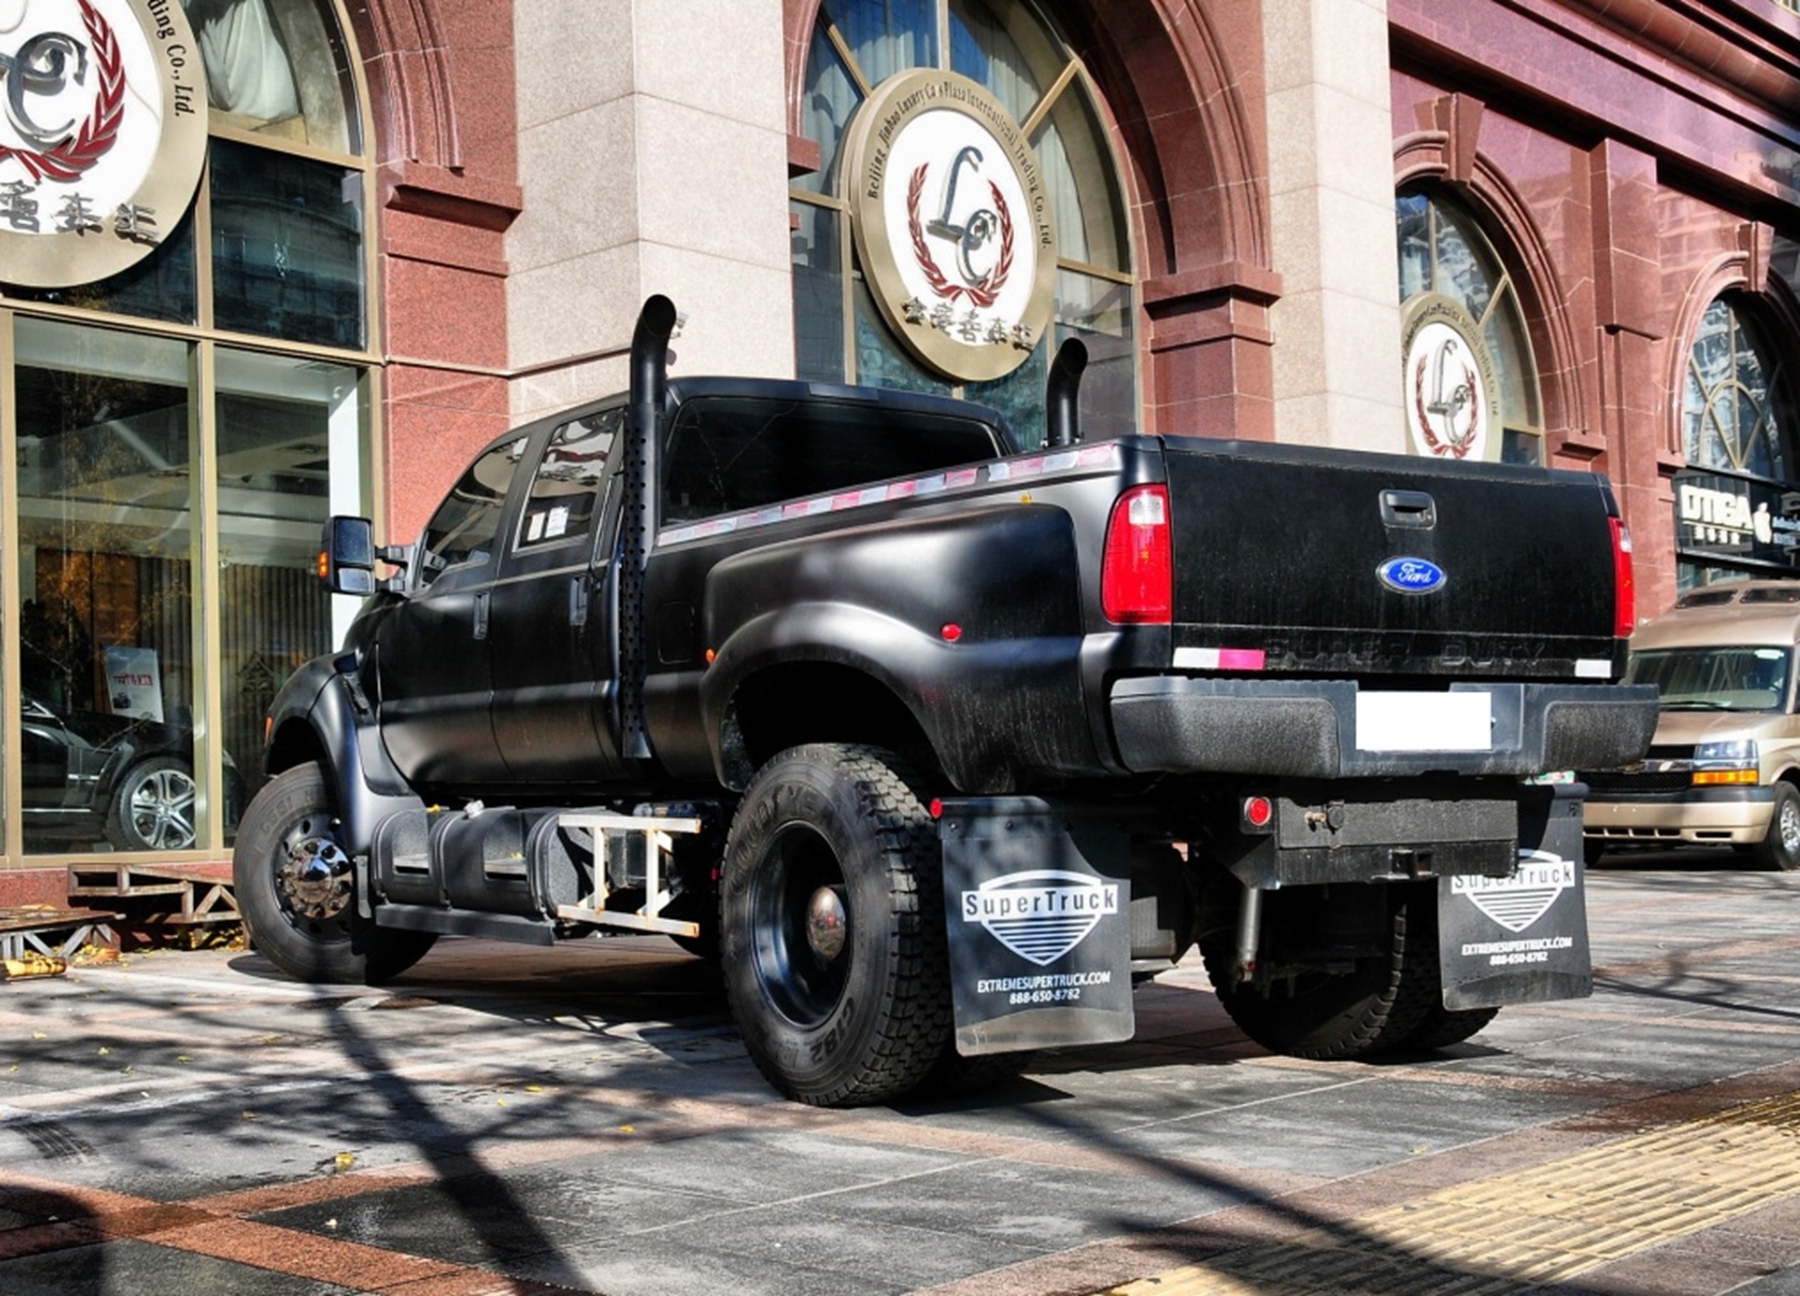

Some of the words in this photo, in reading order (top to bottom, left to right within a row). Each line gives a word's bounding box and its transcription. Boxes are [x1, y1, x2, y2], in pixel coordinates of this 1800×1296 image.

[166, 44, 187, 80] Co.,
[174, 83, 195, 117] Ltd.
[867, 147, 887, 199] Beijing
[896, 89, 926, 114] Luxury
[1014, 144, 1039, 193] Trading
[1040, 224, 1052, 249] Ltd.
[1397, 561, 1433, 583] Ford
[965, 888, 1115, 917] SuperTruck
[977, 971, 1111, 993] EXTREMESUPERTRUCK.COM
